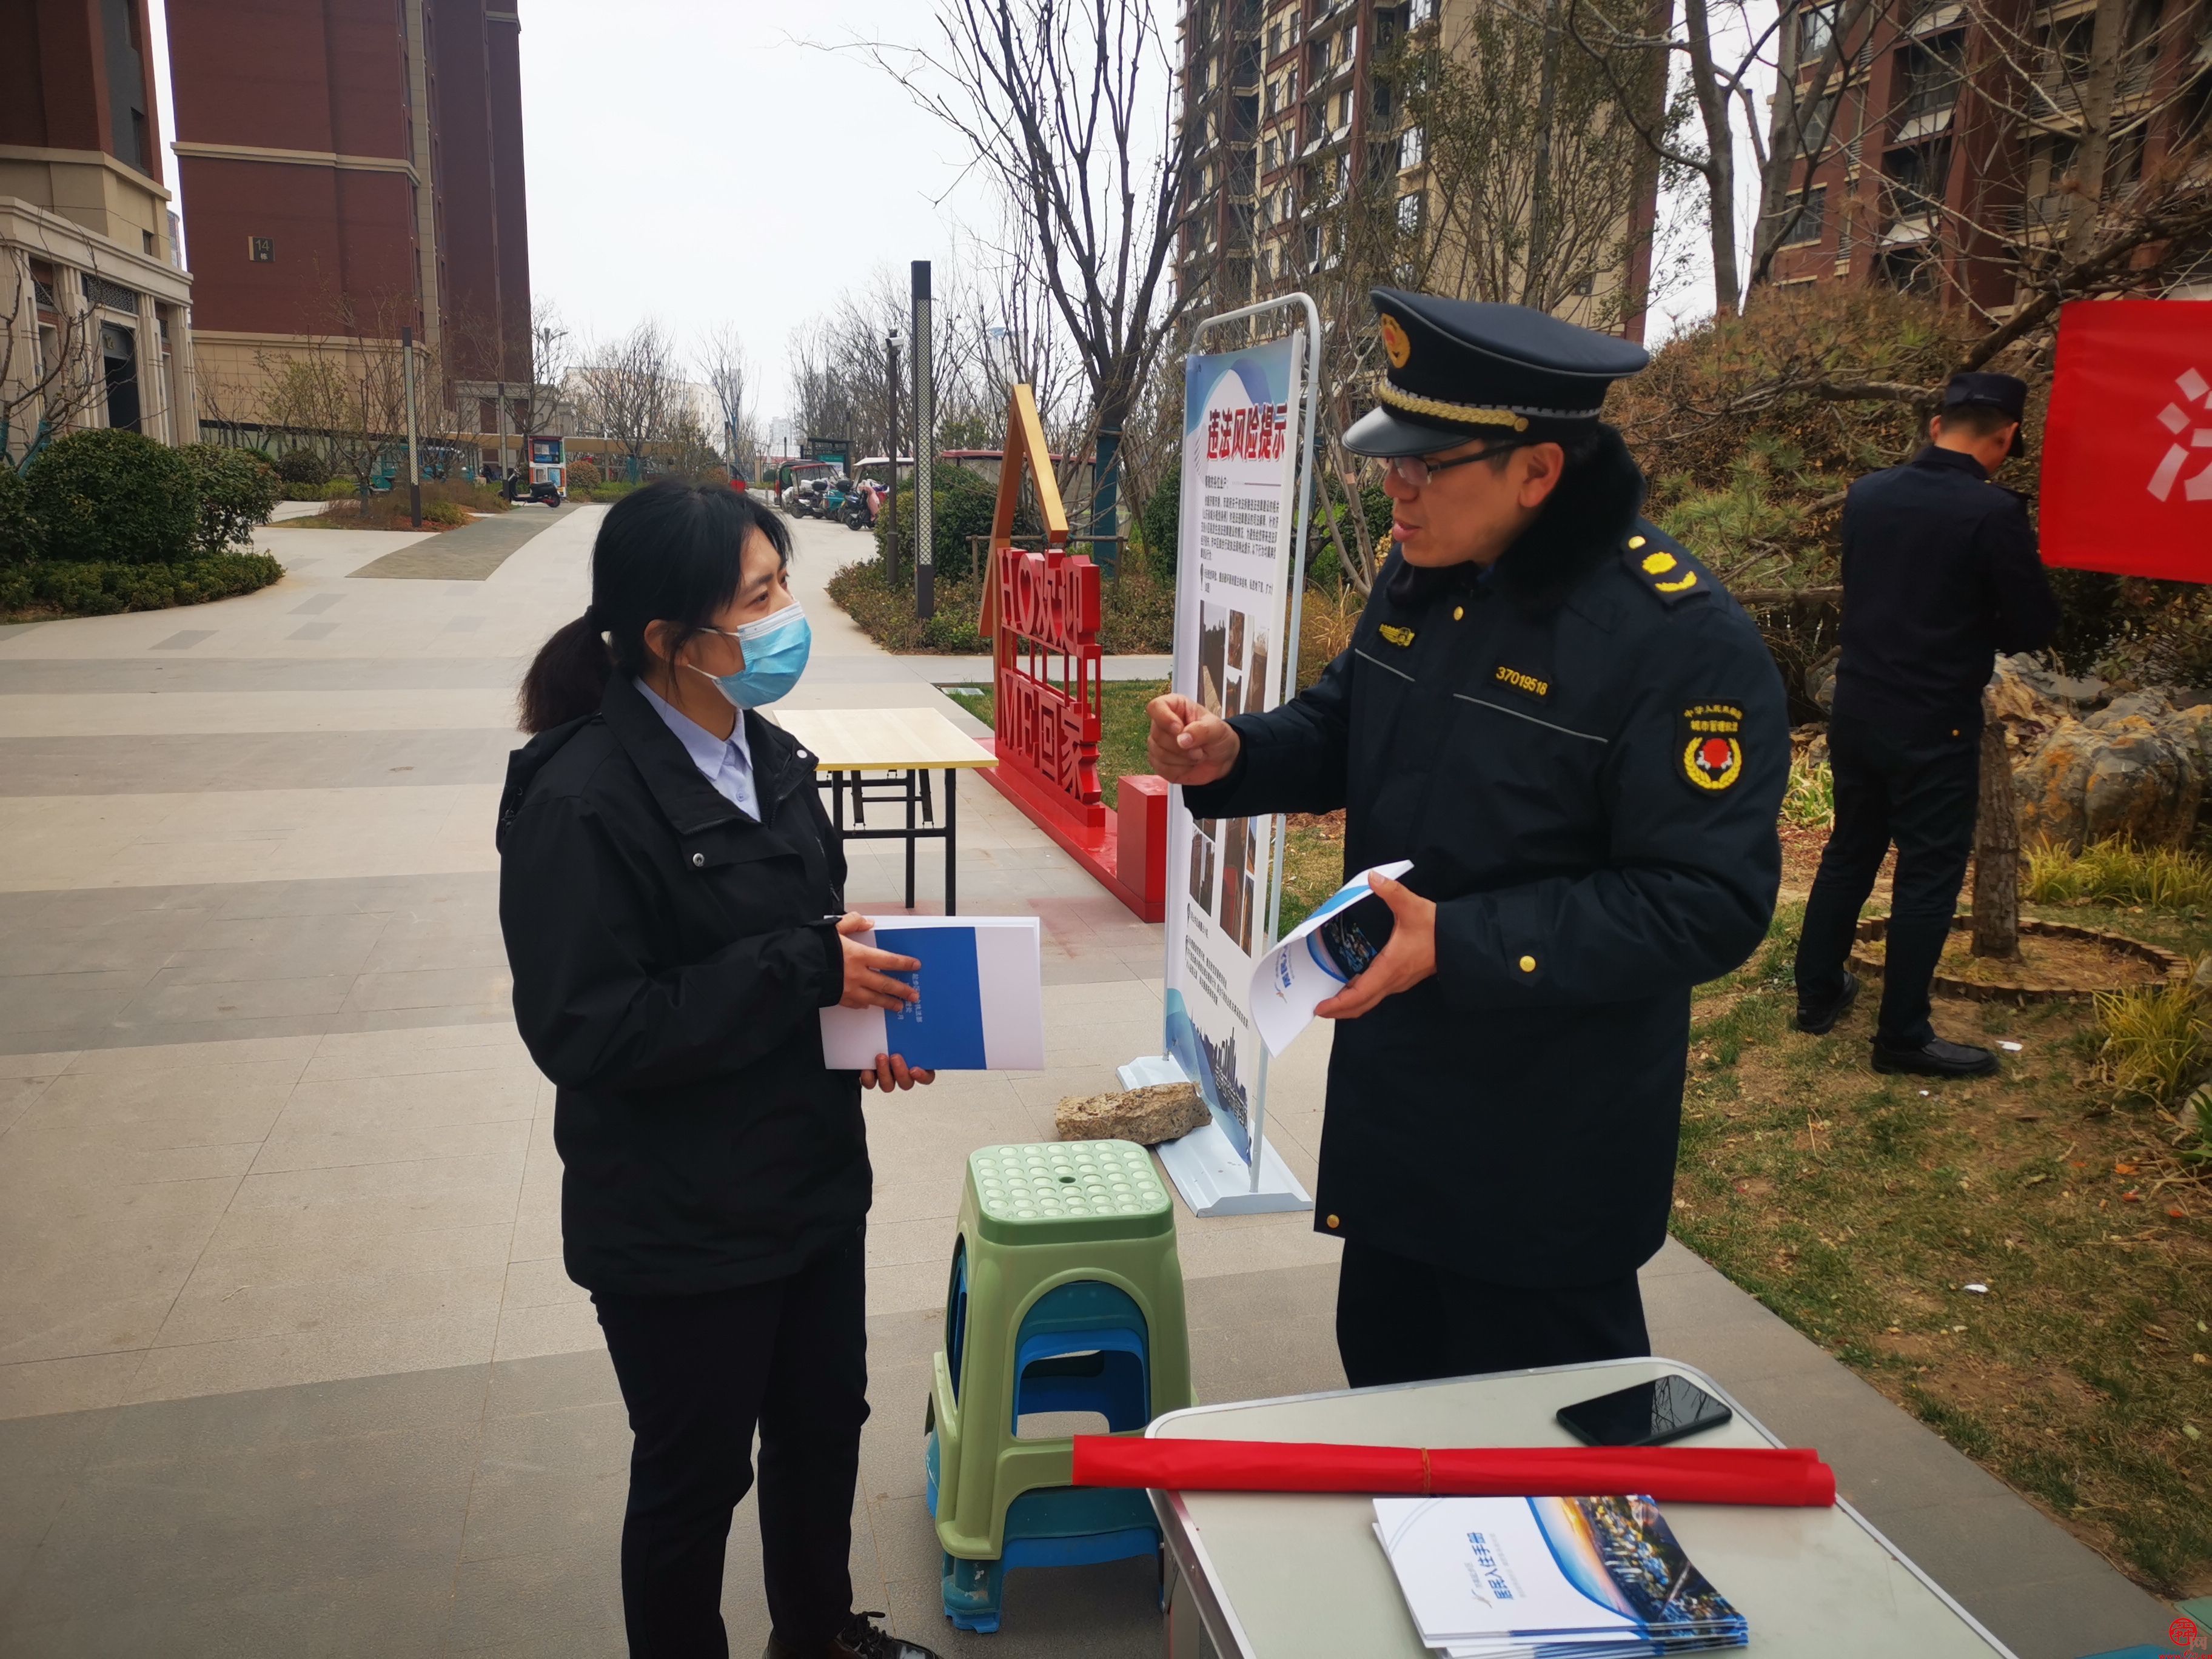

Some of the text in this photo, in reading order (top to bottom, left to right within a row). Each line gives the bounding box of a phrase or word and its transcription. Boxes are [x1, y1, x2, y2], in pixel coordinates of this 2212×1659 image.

[255, 239, 270, 252] 14
[1207, 403, 1288, 461] 违法风险提示
[1495, 666, 1548, 696] 37019518
[1467, 1532, 1514, 1600] 居民入住手册
